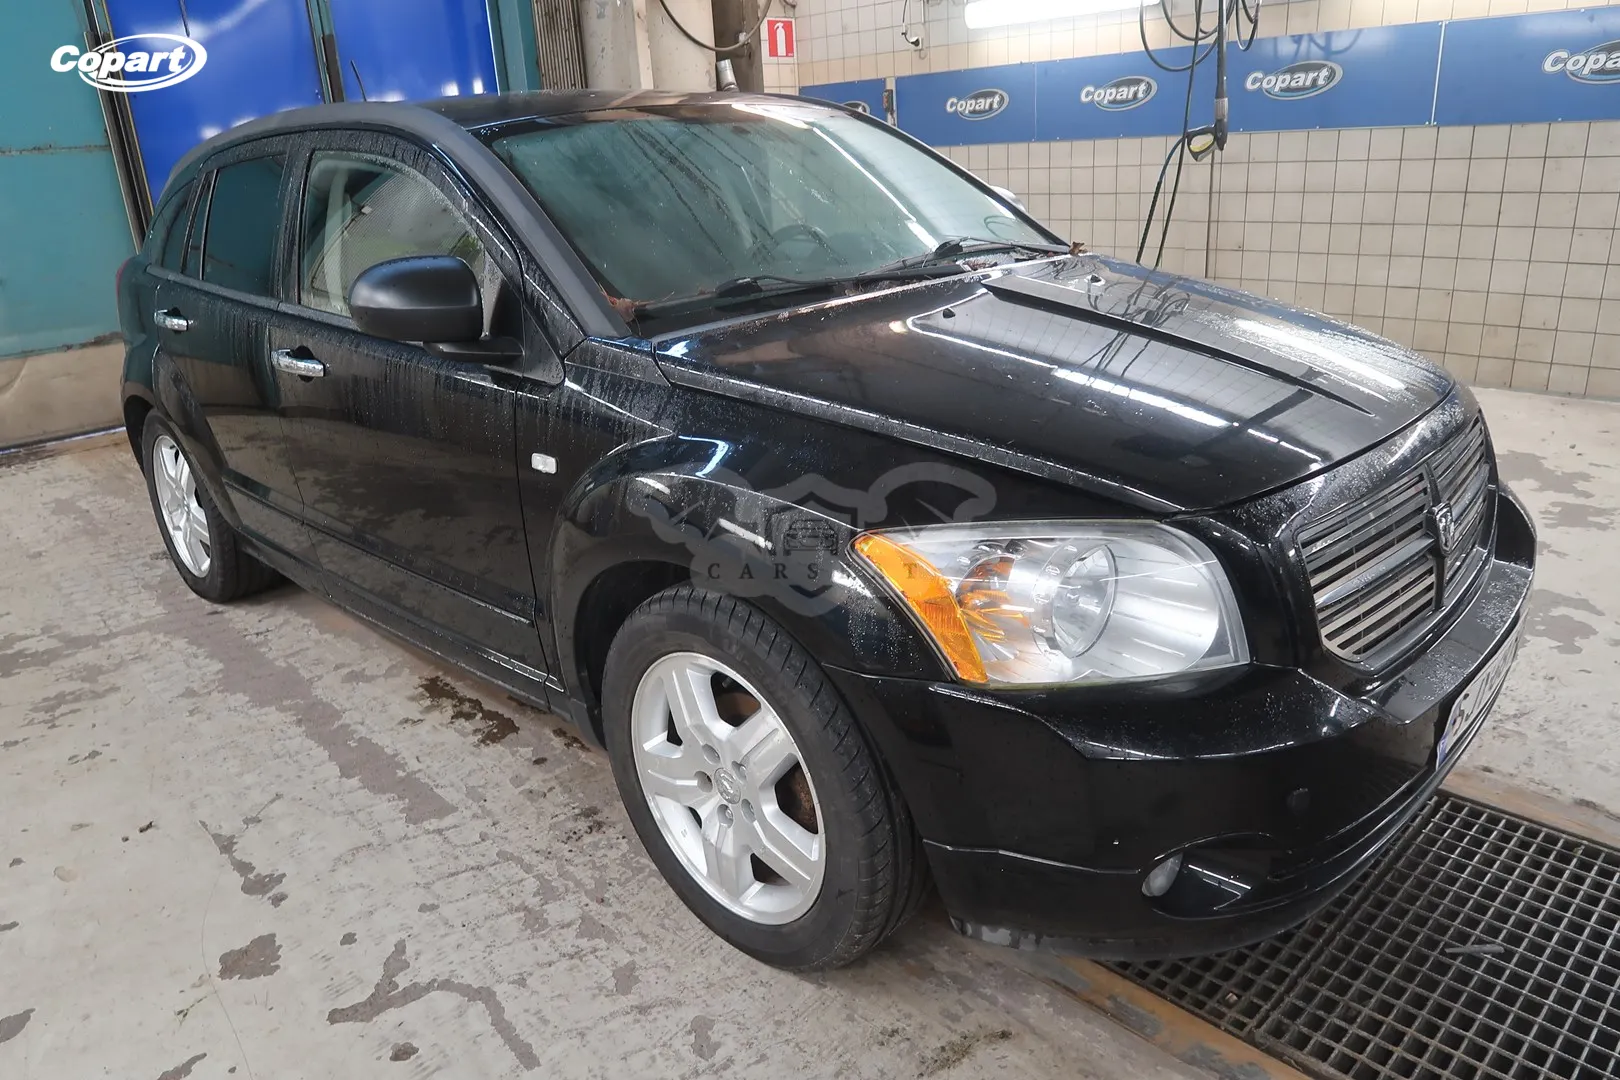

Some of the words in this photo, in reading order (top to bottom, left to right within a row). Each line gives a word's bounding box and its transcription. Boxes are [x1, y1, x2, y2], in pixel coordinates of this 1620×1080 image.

[1246, 67, 1329, 92] Copart
[946, 94, 1000, 114] Copart
[1081, 81, 1147, 104] Copart
